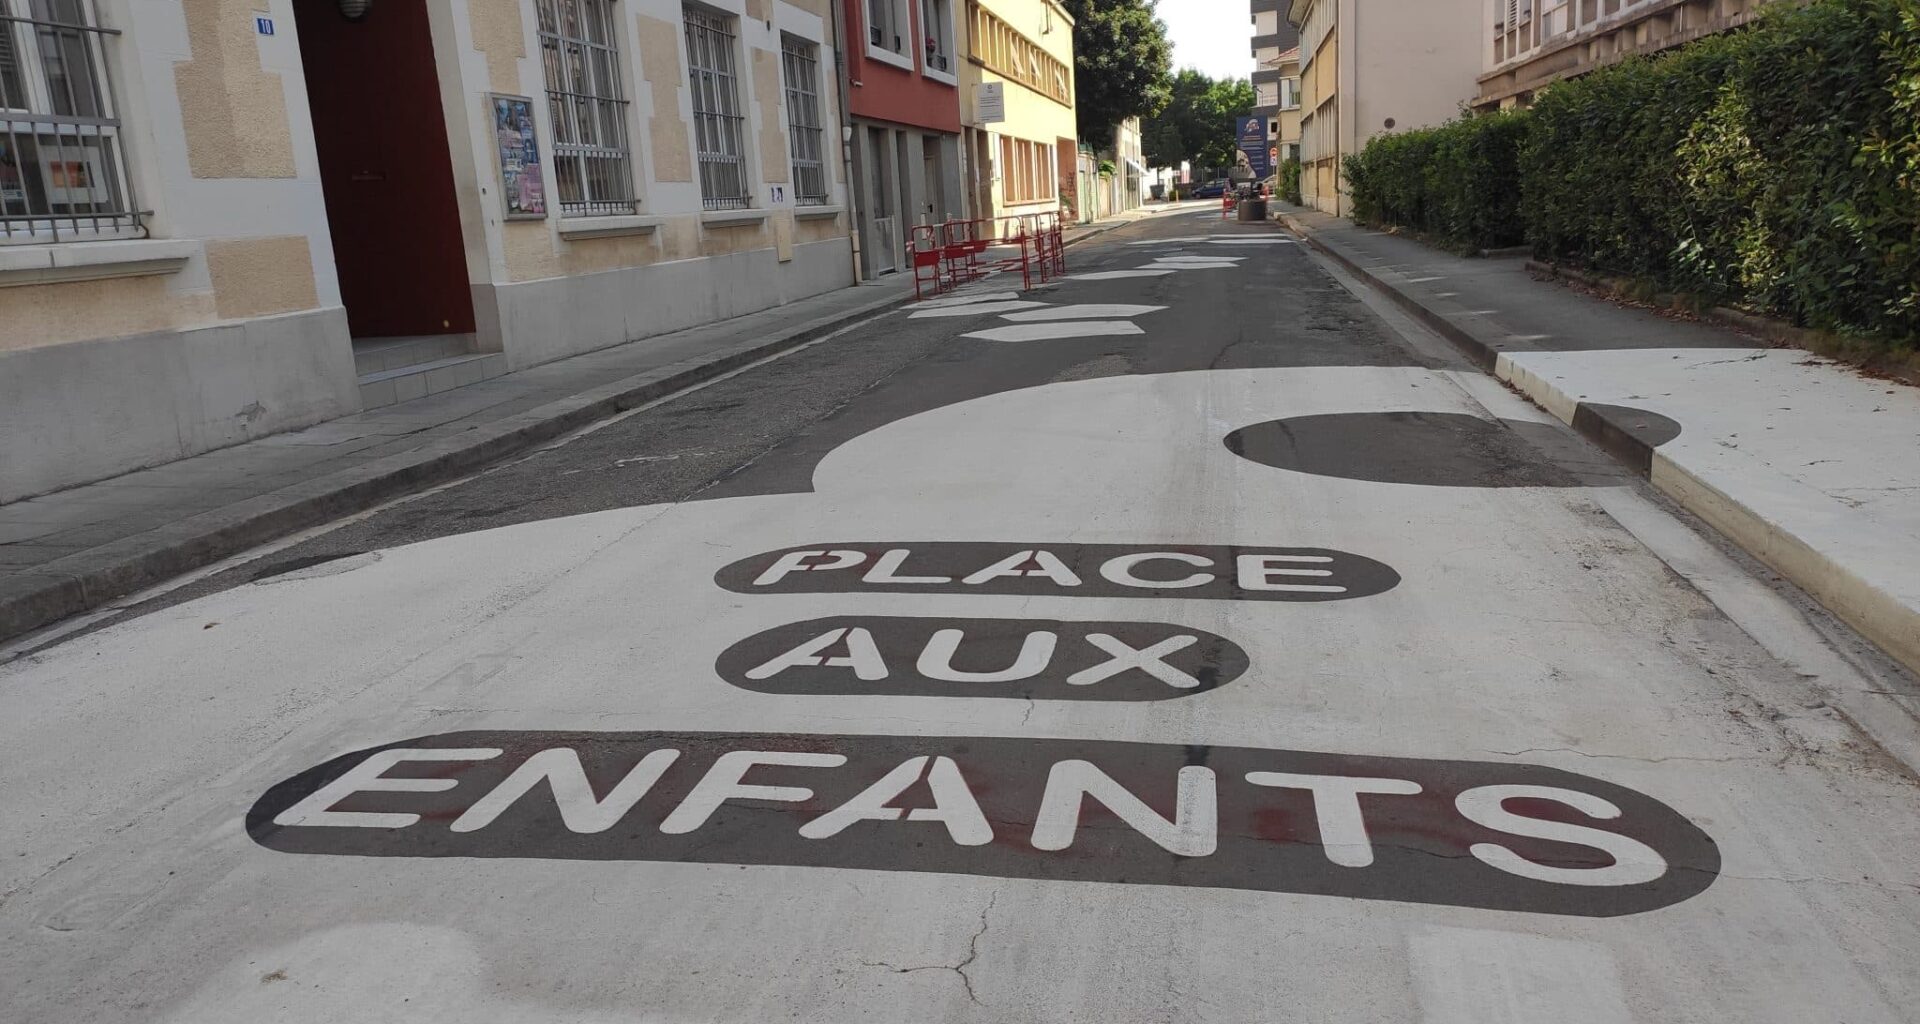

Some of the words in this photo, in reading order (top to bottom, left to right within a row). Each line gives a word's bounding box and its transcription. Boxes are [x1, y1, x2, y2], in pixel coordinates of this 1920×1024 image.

[261, 19, 272, 34] 10
[753, 549, 1347, 592] PLACE
[745, 627, 1200, 688] AUX
[274, 747, 1668, 886] ENFANTS
